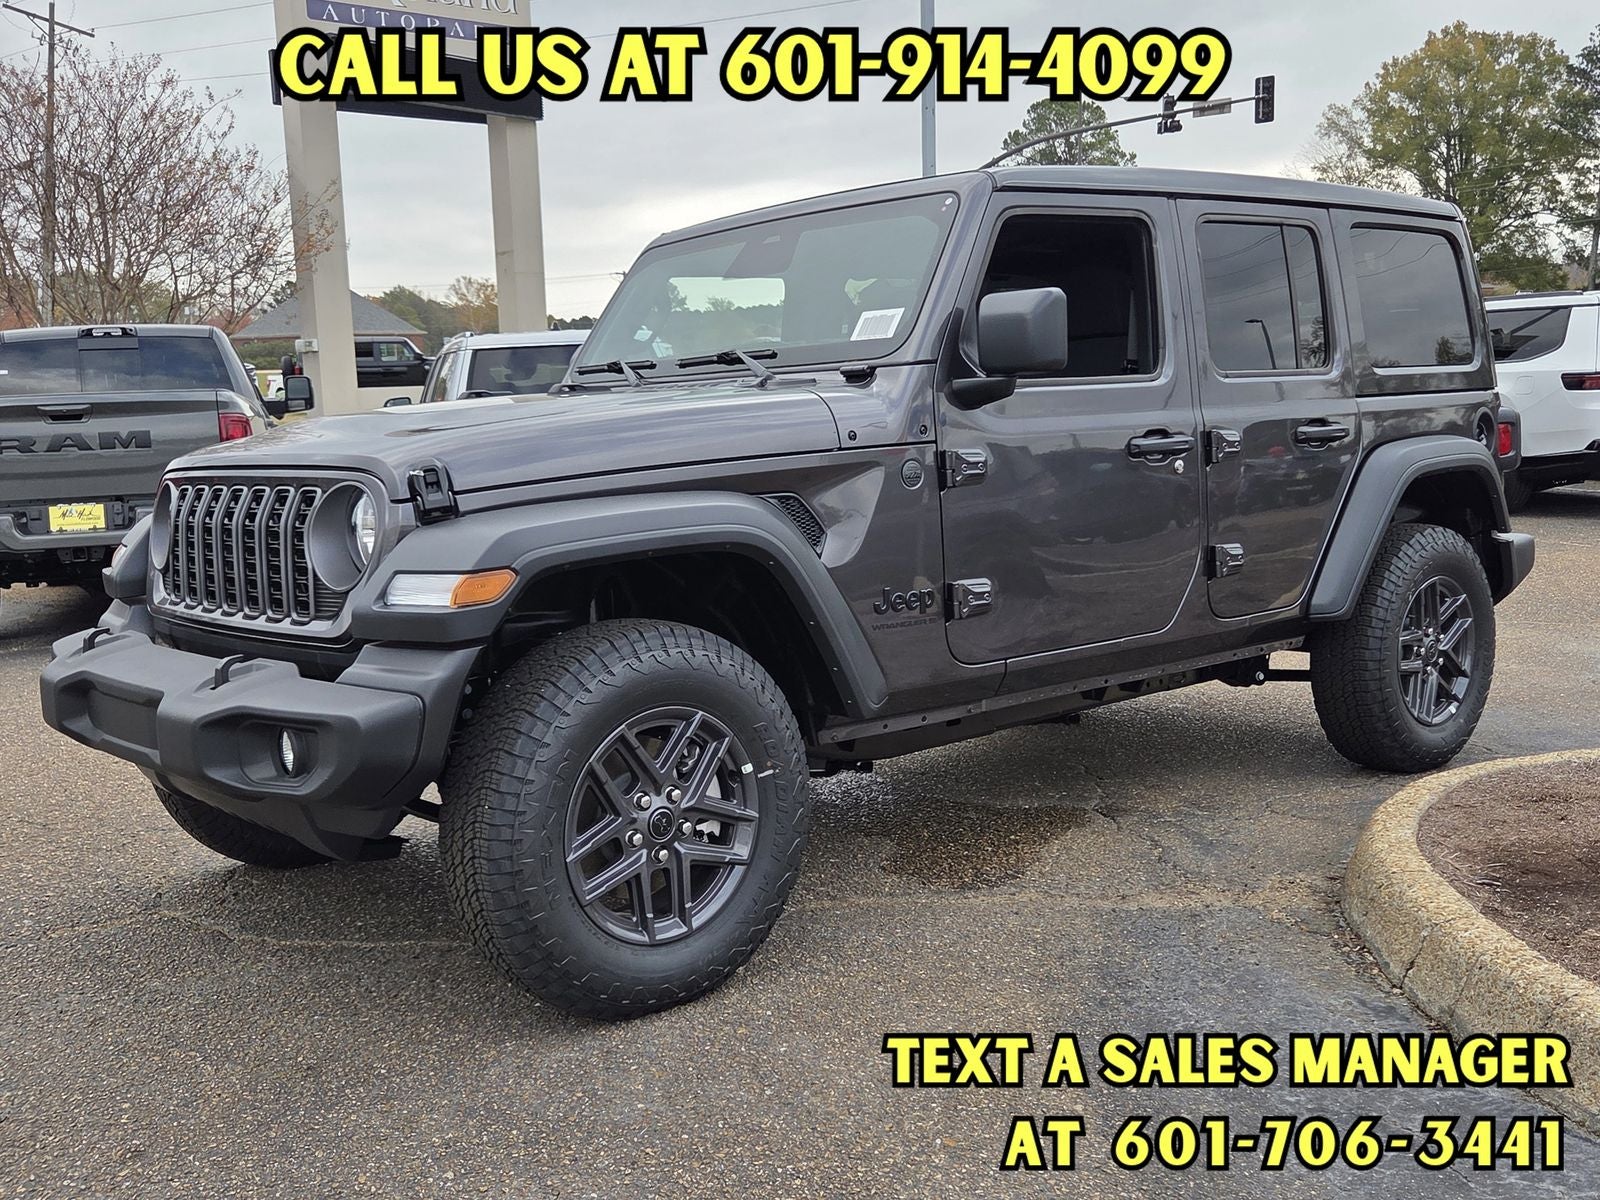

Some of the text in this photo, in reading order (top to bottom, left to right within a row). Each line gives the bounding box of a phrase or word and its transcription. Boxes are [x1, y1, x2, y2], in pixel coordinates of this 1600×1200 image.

[322, 3, 482, 40] AUTOPA
[0, 430, 152, 454] RAM
[873, 587, 935, 615] Jeep
[871, 618, 928, 631] WRANGLER
